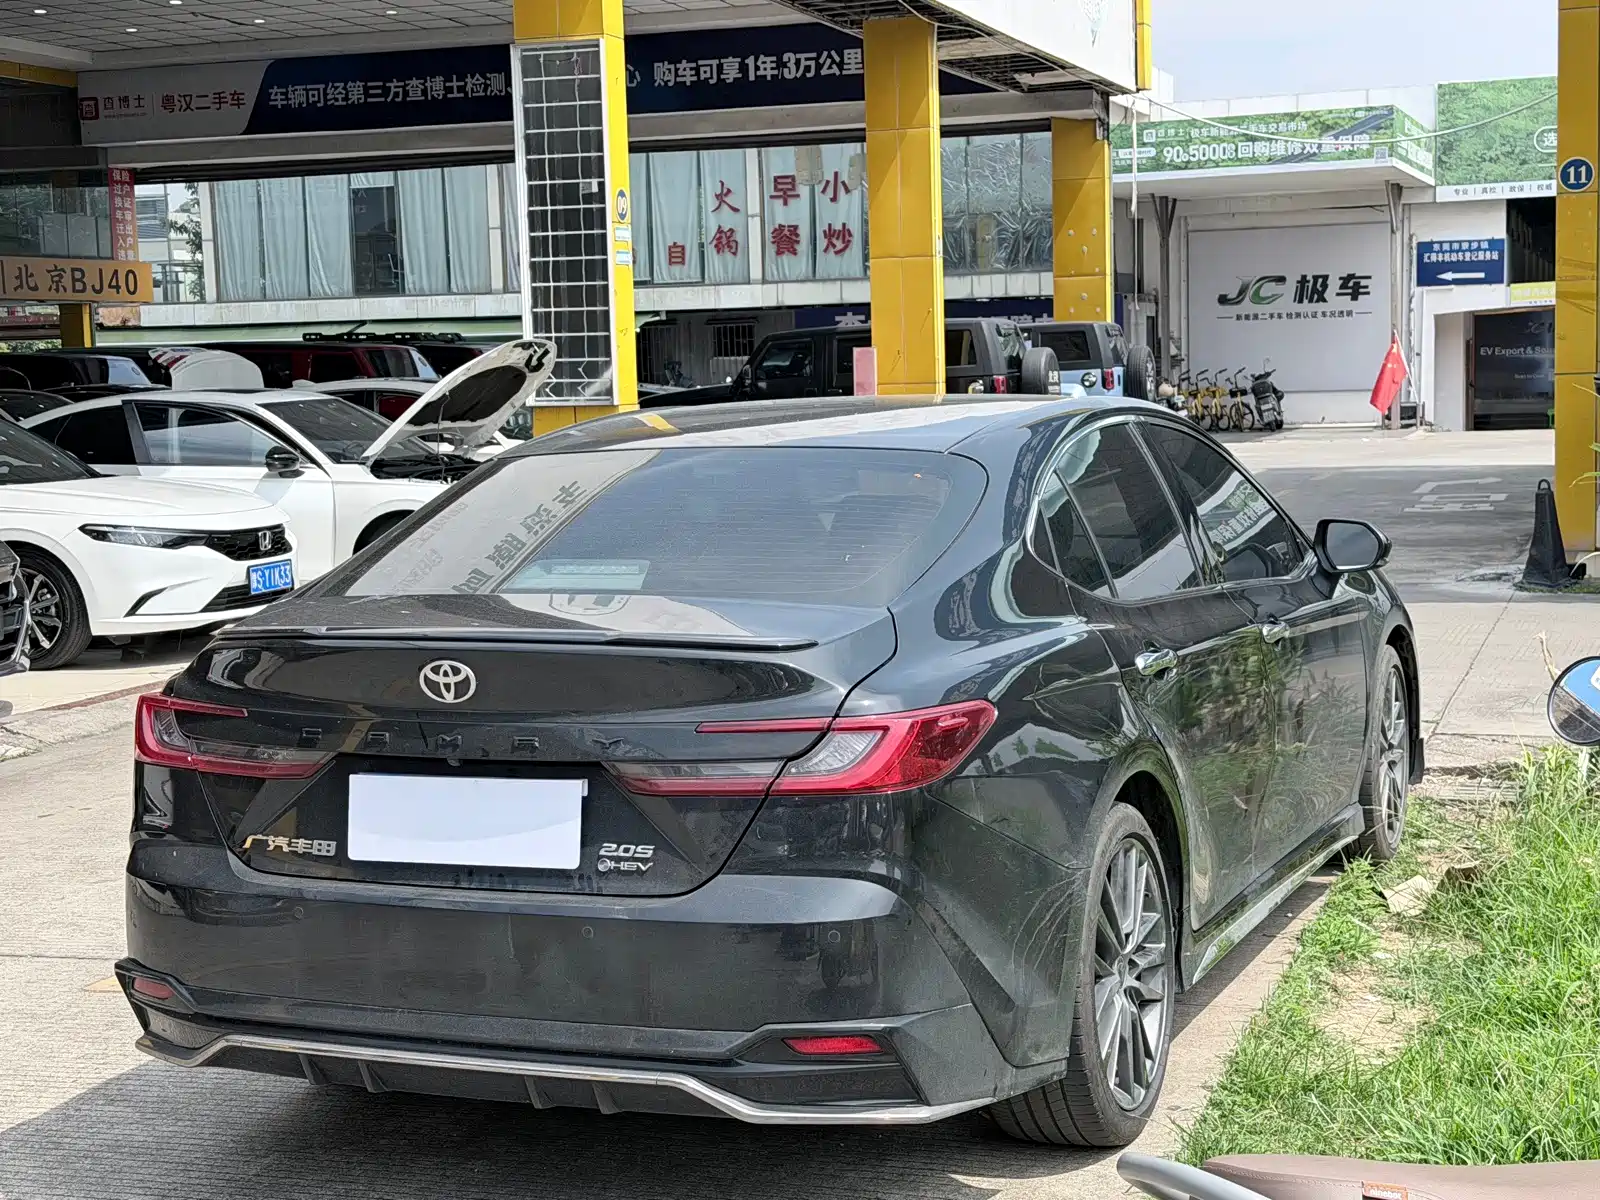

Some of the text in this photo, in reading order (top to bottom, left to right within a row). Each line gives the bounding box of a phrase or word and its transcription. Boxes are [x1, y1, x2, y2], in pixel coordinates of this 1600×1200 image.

[160, 90, 246, 113] 粤汉二手车
[1567, 165, 1589, 184] 11
[708, 179, 740, 258] 火锅
[769, 174, 800, 257] 早餐
[820, 171, 854, 256] 小炒
[1217, 273, 1372, 306] JC 极车
[1480, 346, 1493, 356] EV
[1494, 346, 1525, 357] Export
[242, 834, 337, 857] 广汽丰田
